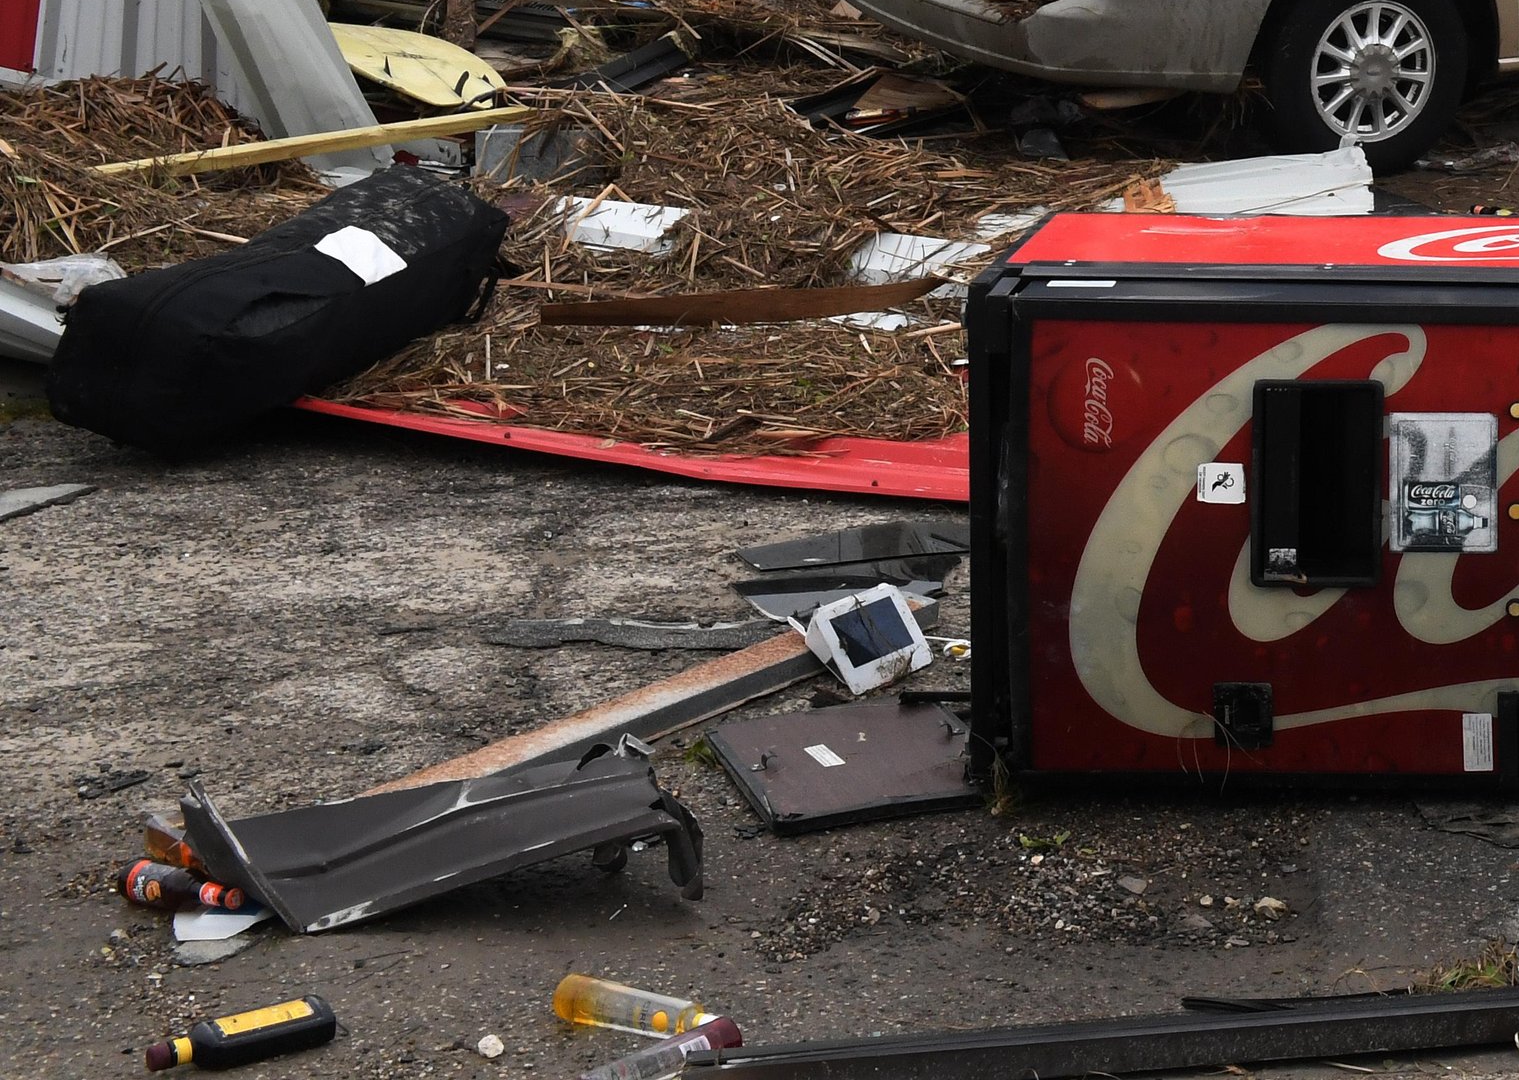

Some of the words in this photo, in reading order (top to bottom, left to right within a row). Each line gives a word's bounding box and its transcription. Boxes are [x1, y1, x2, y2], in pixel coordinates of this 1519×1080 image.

[1084, 357, 1114, 448] Coca-Cola
[1410, 484, 1456, 499] Coca-Cola
[1420, 498, 1446, 506] zero
